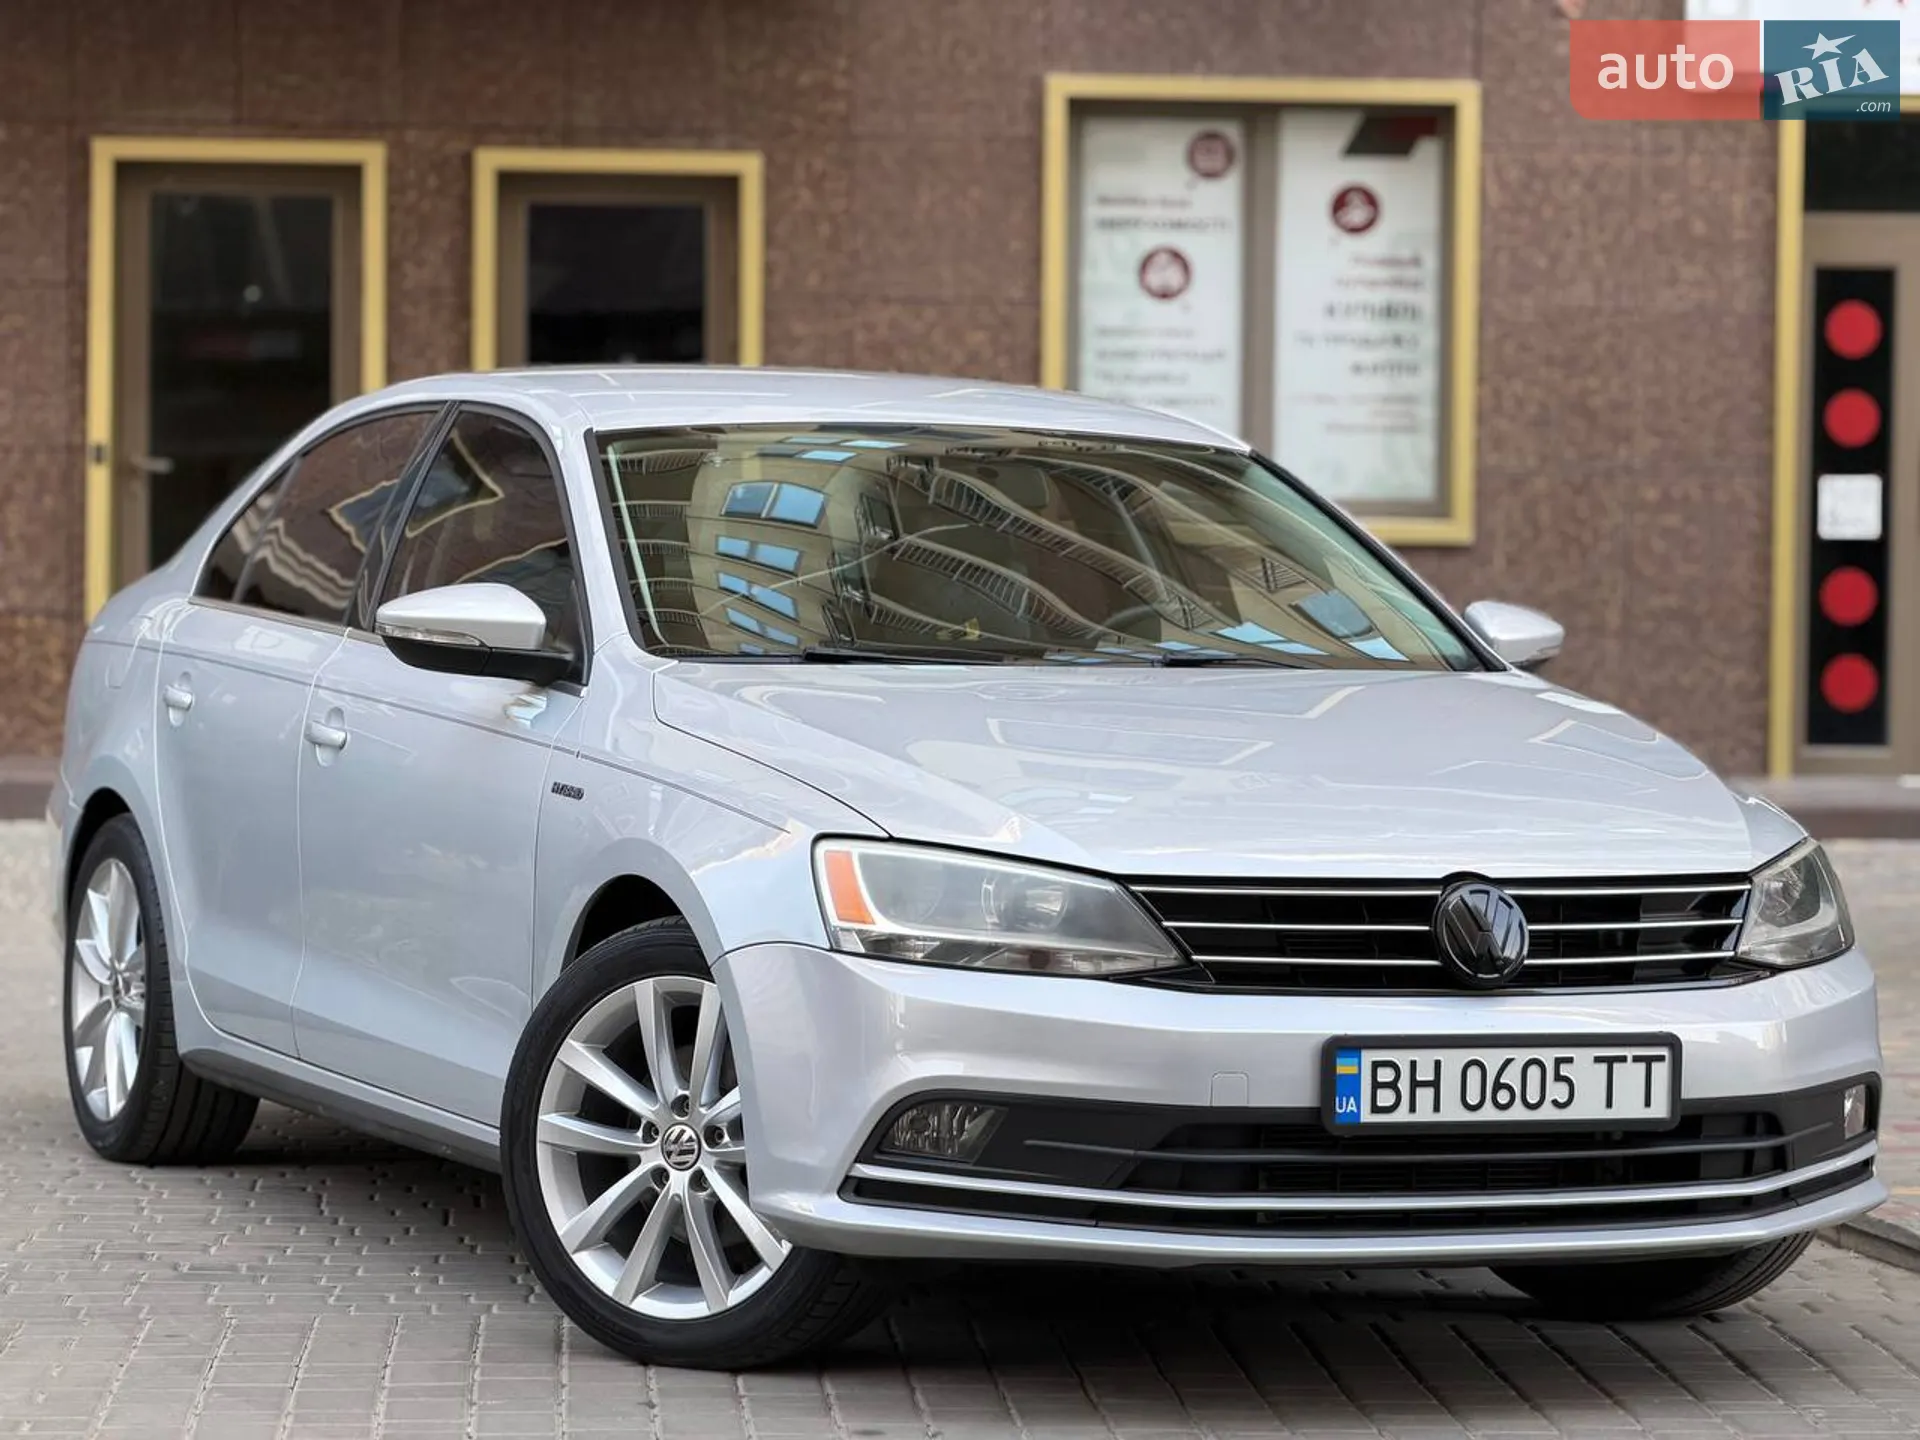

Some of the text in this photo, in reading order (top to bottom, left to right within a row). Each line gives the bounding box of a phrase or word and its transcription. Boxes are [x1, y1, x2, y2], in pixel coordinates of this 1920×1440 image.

[1370, 1055, 1666, 1114] BH 0605 TT
[1334, 1096, 1358, 1114] UA
